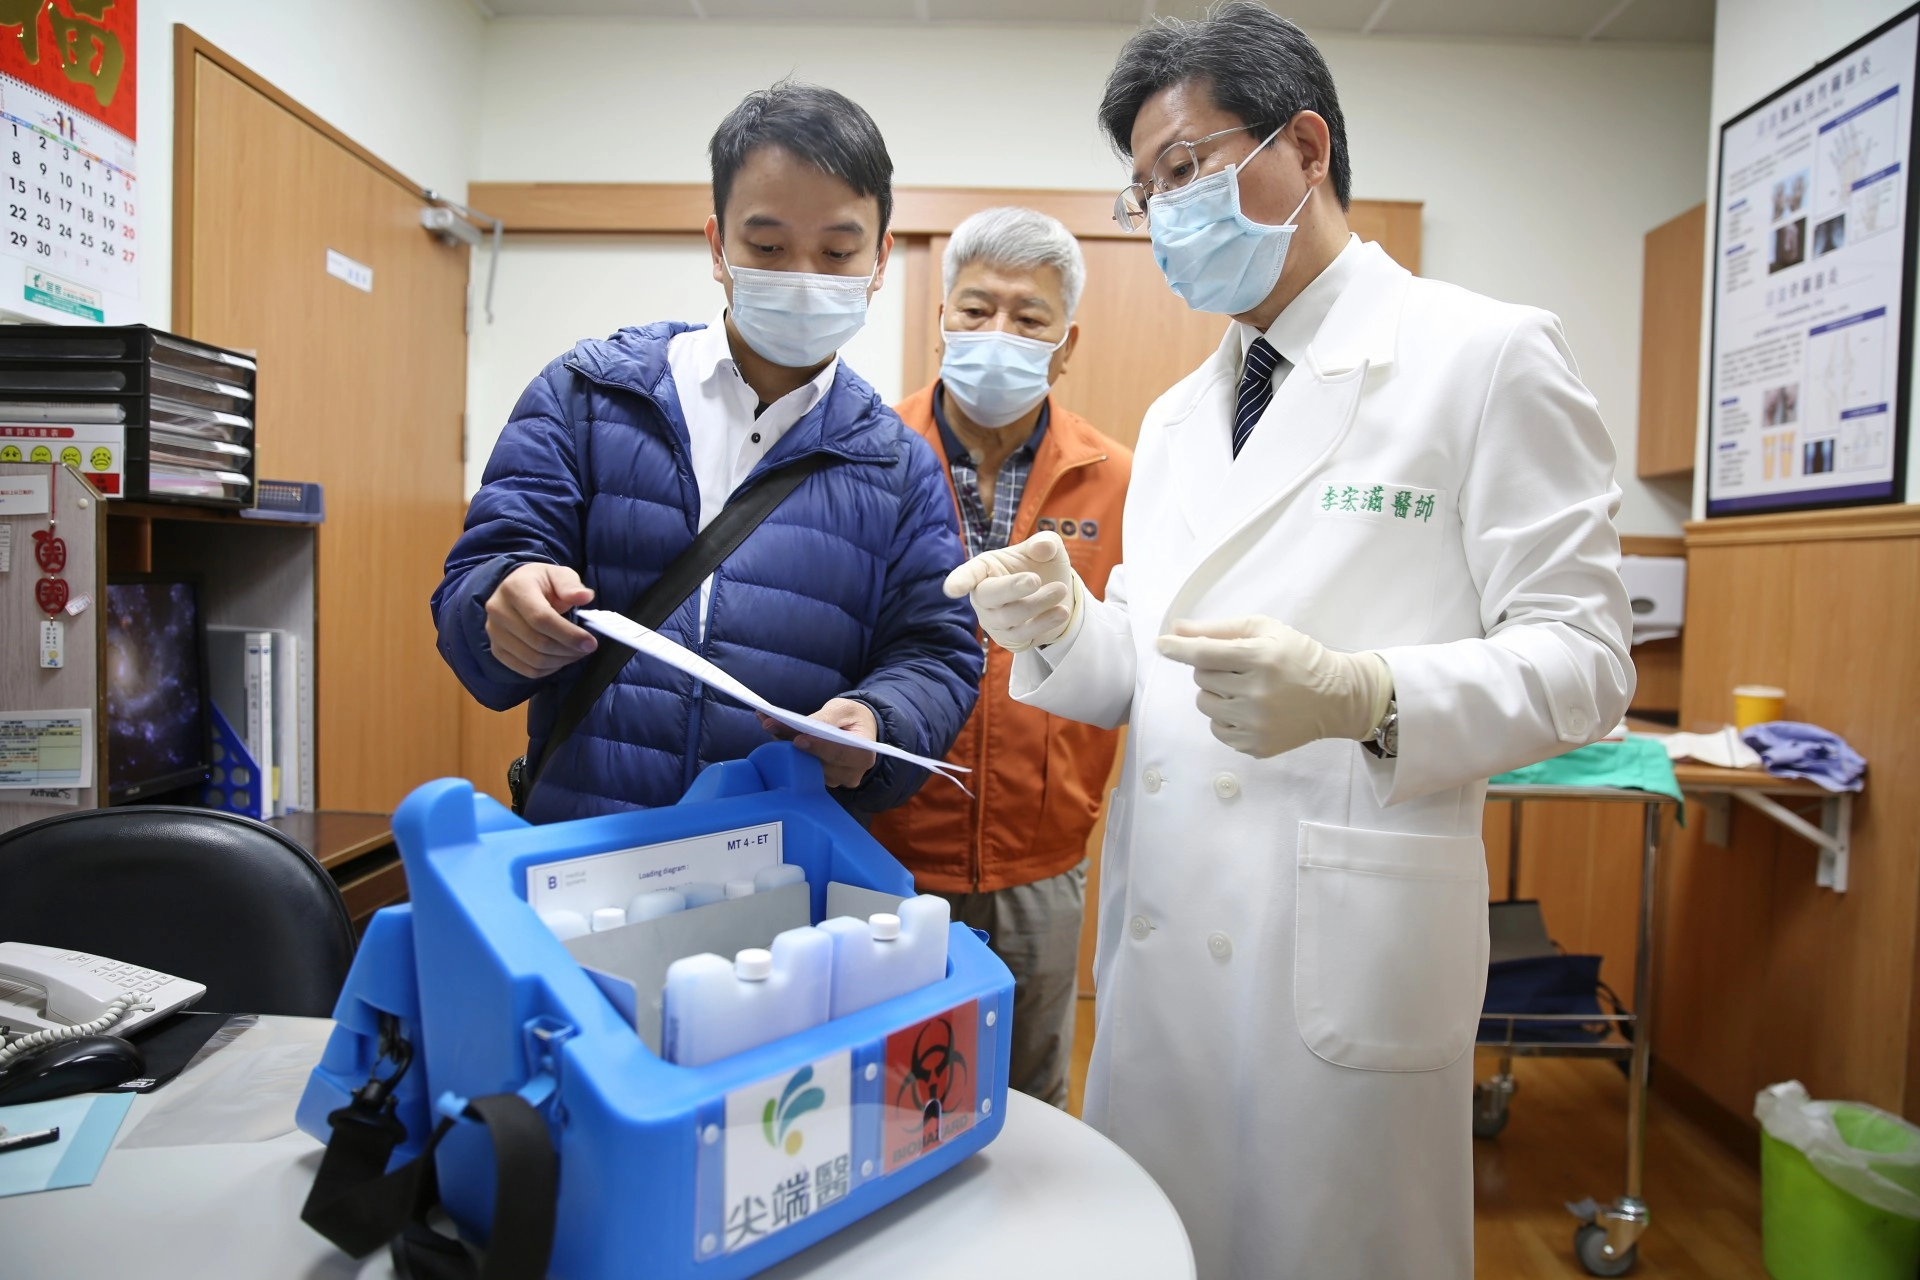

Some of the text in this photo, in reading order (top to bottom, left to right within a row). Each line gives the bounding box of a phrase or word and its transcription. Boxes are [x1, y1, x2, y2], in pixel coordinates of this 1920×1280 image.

[12, 123, 18, 137] 1
[39, 136, 47, 150] 2
[63, 147, 70, 160] 3
[84, 159, 91, 171] 4
[106, 169, 112, 181] 5
[12, 151, 21, 165] 8
[39, 162, 47, 175] 9
[60, 172, 73, 188] 10
[81, 182, 93, 198] 11
[103, 192, 115, 208] 12
[9, 176, 135, 240] 15 16 17 18 19 20
[9, 203, 135, 263] 22 23 24 25 26 27
[10, 231, 28, 247] 29
[36, 240, 51, 256] 30
[1390, 490, 1436, 523] 醫師
[727, 838, 742, 851] MT
[743, 837, 749, 847] 4
[757, 833, 769, 845] ET
[548, 875, 558, 890] B
[638, 869, 662, 880] Loading
[726, 1153, 849, 1253] 尖端醫
